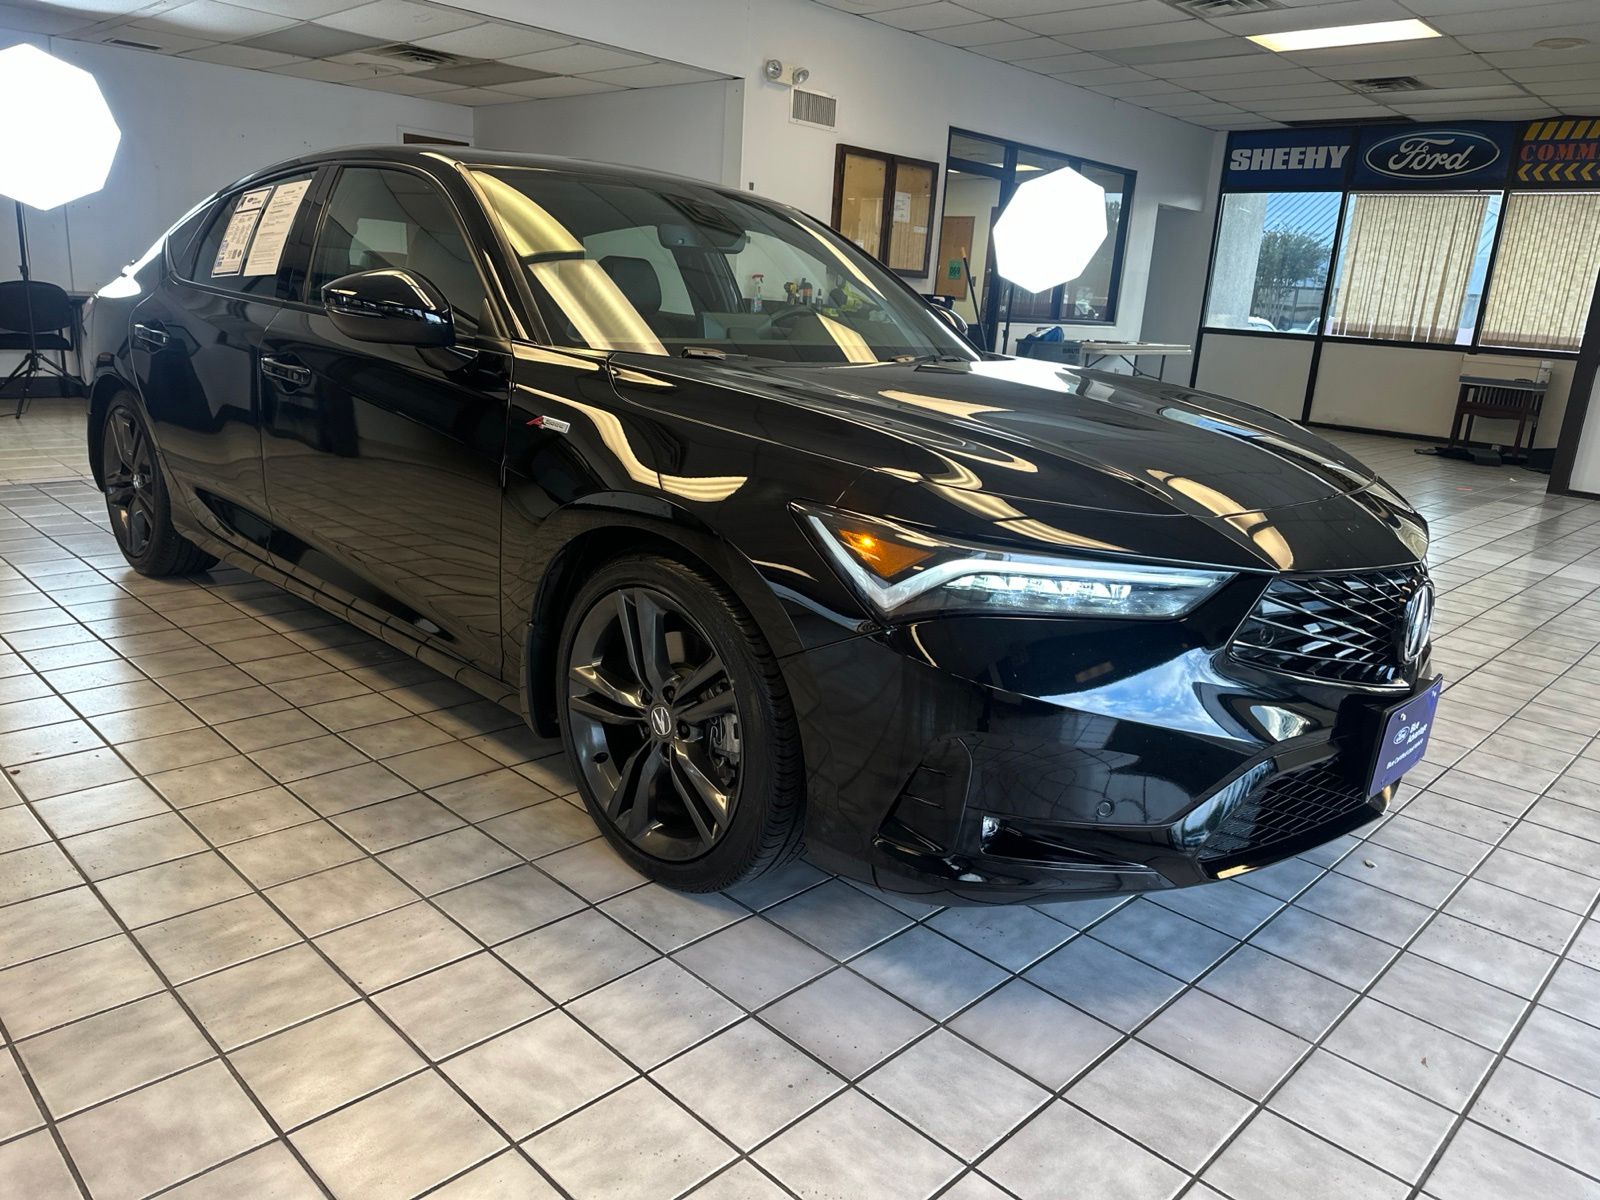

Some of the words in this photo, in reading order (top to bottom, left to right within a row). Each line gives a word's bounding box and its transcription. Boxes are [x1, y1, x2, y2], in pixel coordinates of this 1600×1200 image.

[1229, 145, 1351, 171] SHEEHY
[1388, 137, 1475, 171] Ford
[1520, 143, 1600, 161] COMM
